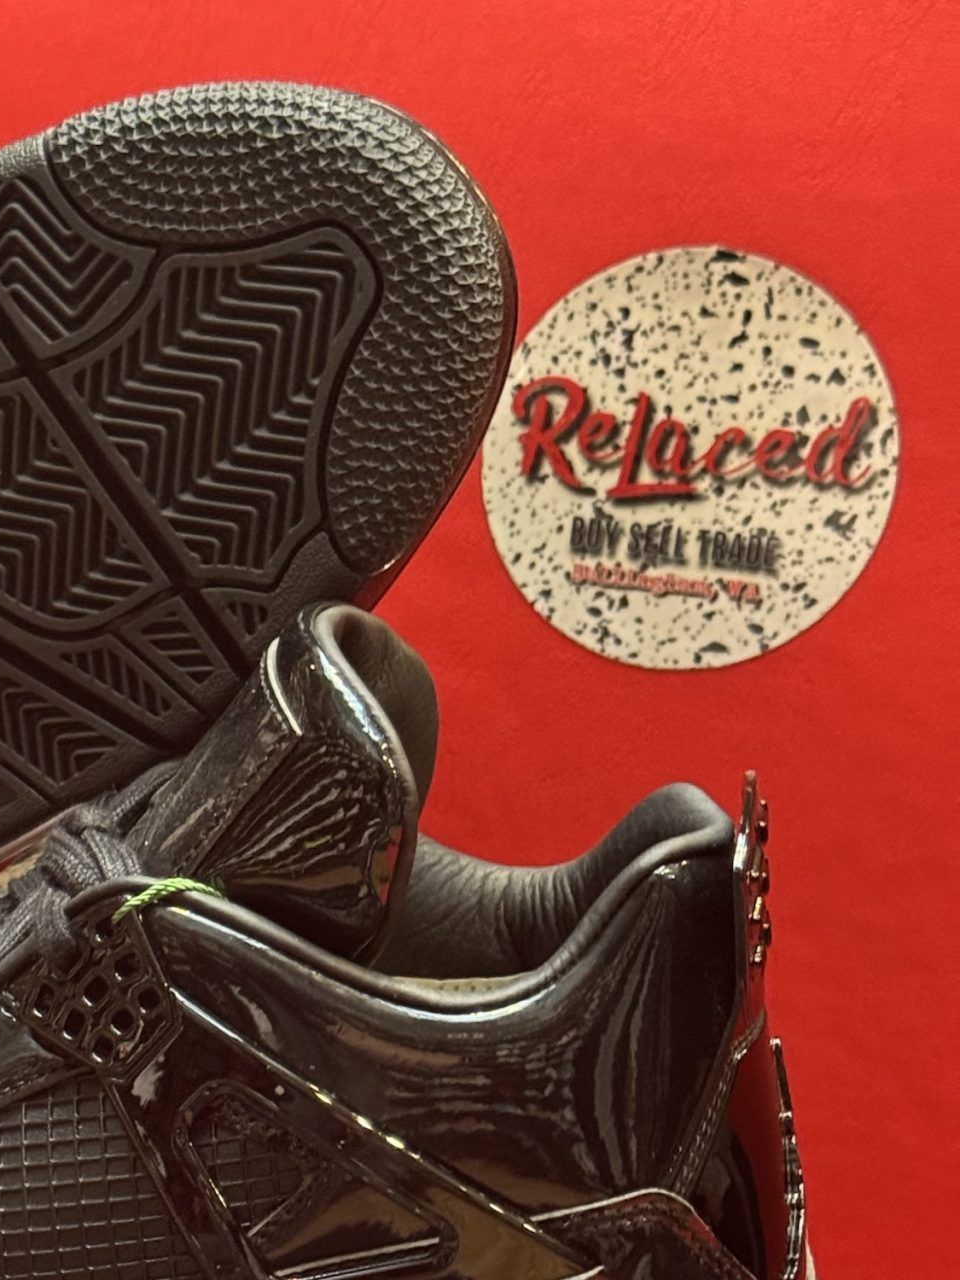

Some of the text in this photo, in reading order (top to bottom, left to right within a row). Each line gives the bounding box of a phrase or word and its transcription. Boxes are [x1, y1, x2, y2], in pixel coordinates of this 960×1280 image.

[570, 516, 782, 574] BUY SELL TRADE
